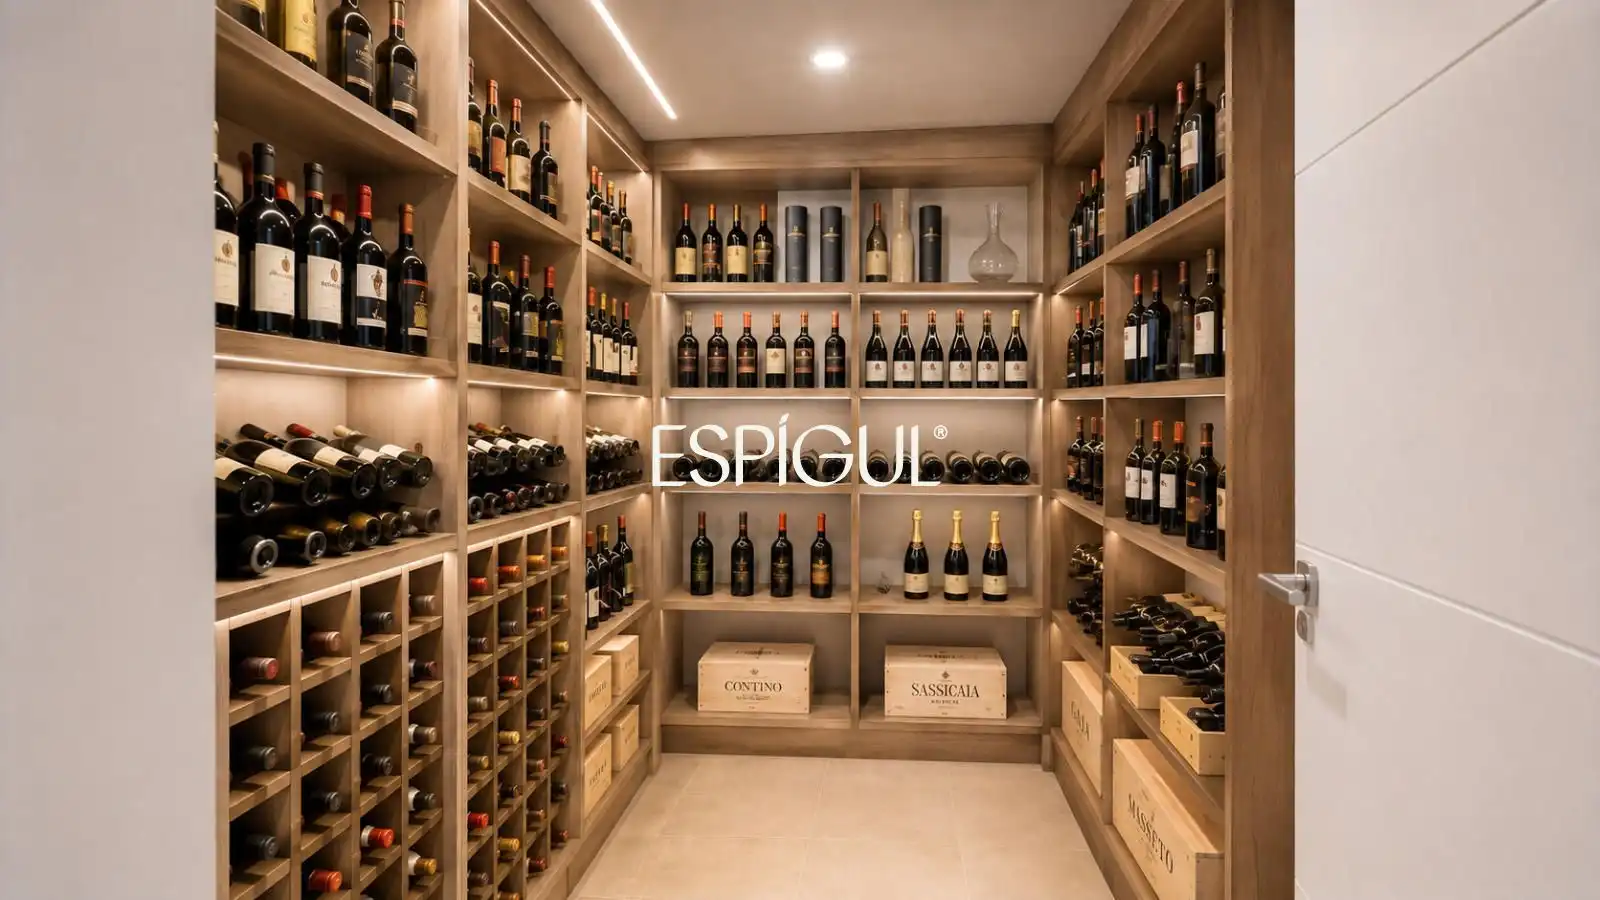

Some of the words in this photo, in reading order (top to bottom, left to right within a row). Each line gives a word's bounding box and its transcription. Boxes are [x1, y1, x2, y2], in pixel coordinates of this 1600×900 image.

[724, 680, 782, 692] CONTINO
[911, 682, 980, 698] SASSICAIA
[1128, 793, 1173, 874] MASSETO
